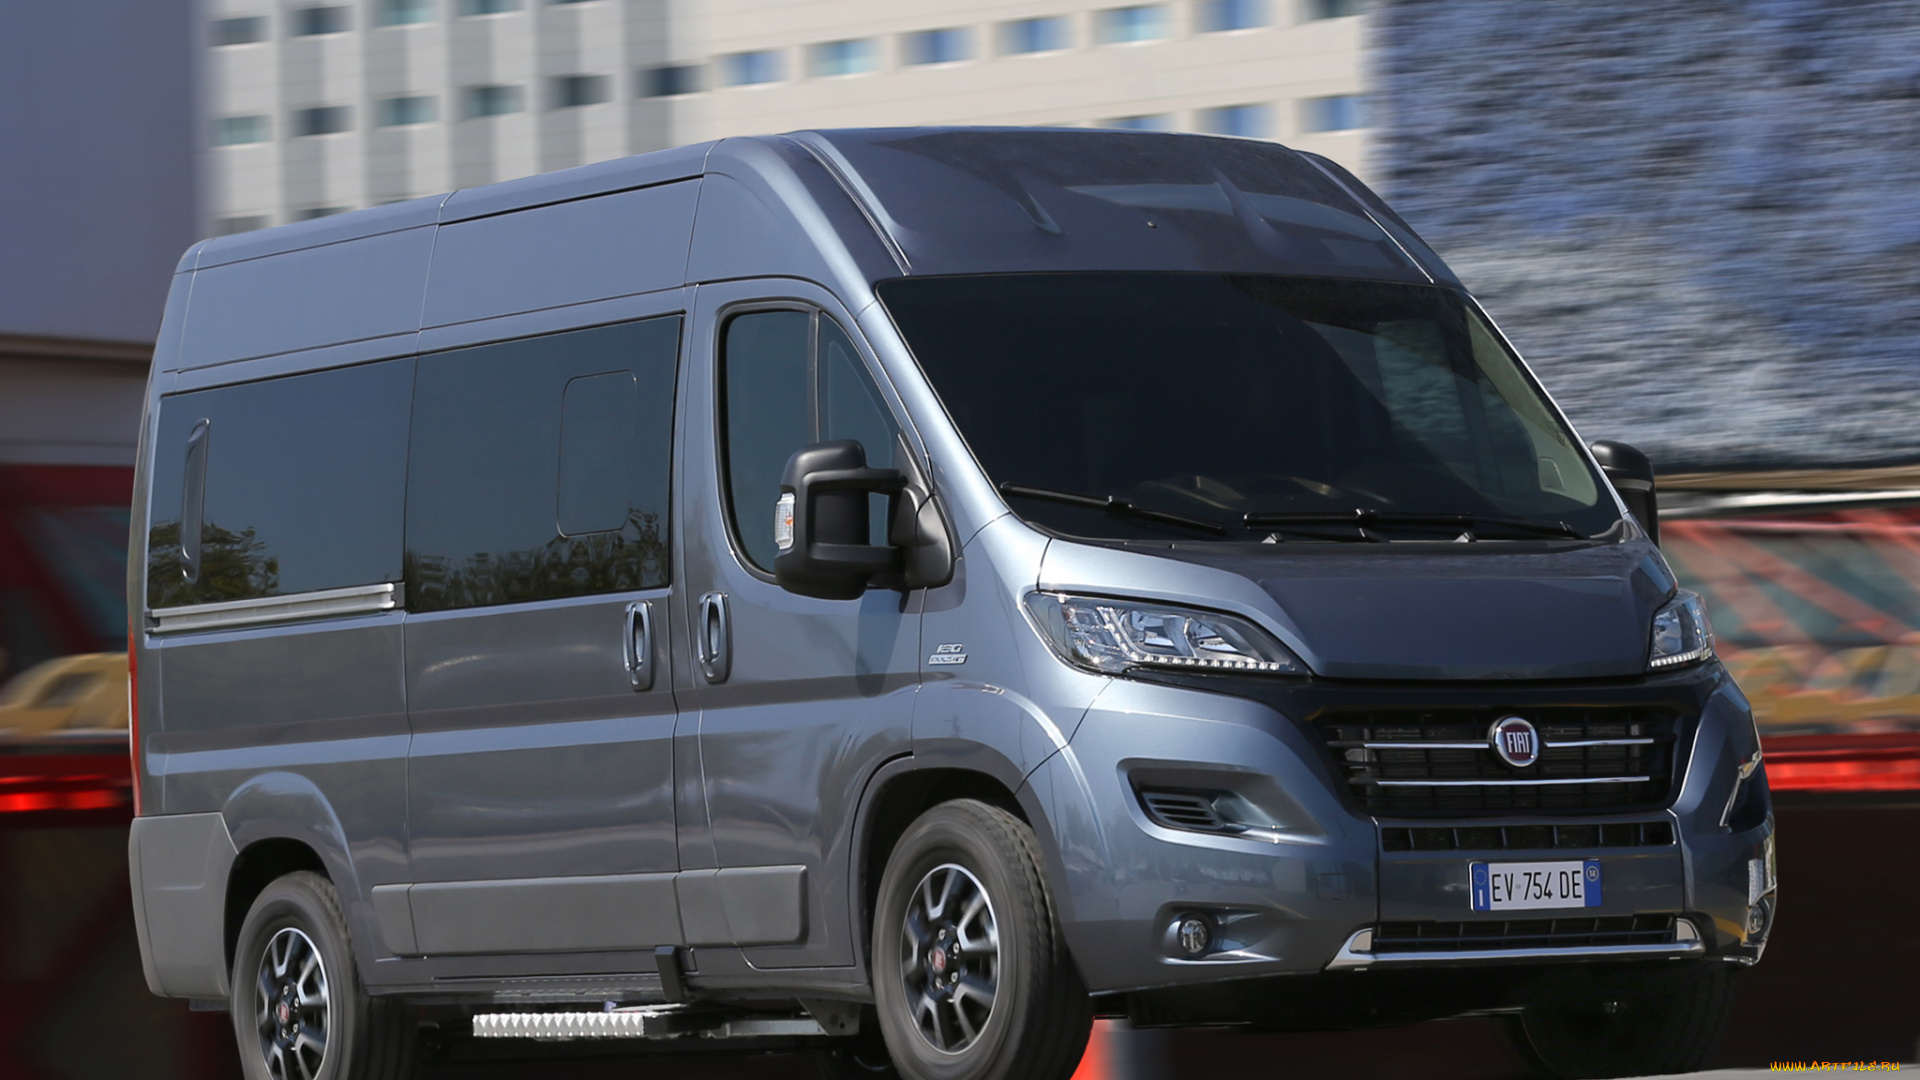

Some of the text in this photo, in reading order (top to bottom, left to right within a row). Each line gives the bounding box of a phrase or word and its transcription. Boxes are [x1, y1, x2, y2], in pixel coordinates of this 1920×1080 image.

[1505, 731, 1530, 754] FIAT
[1491, 869, 1583, 903] EV 754 DE
